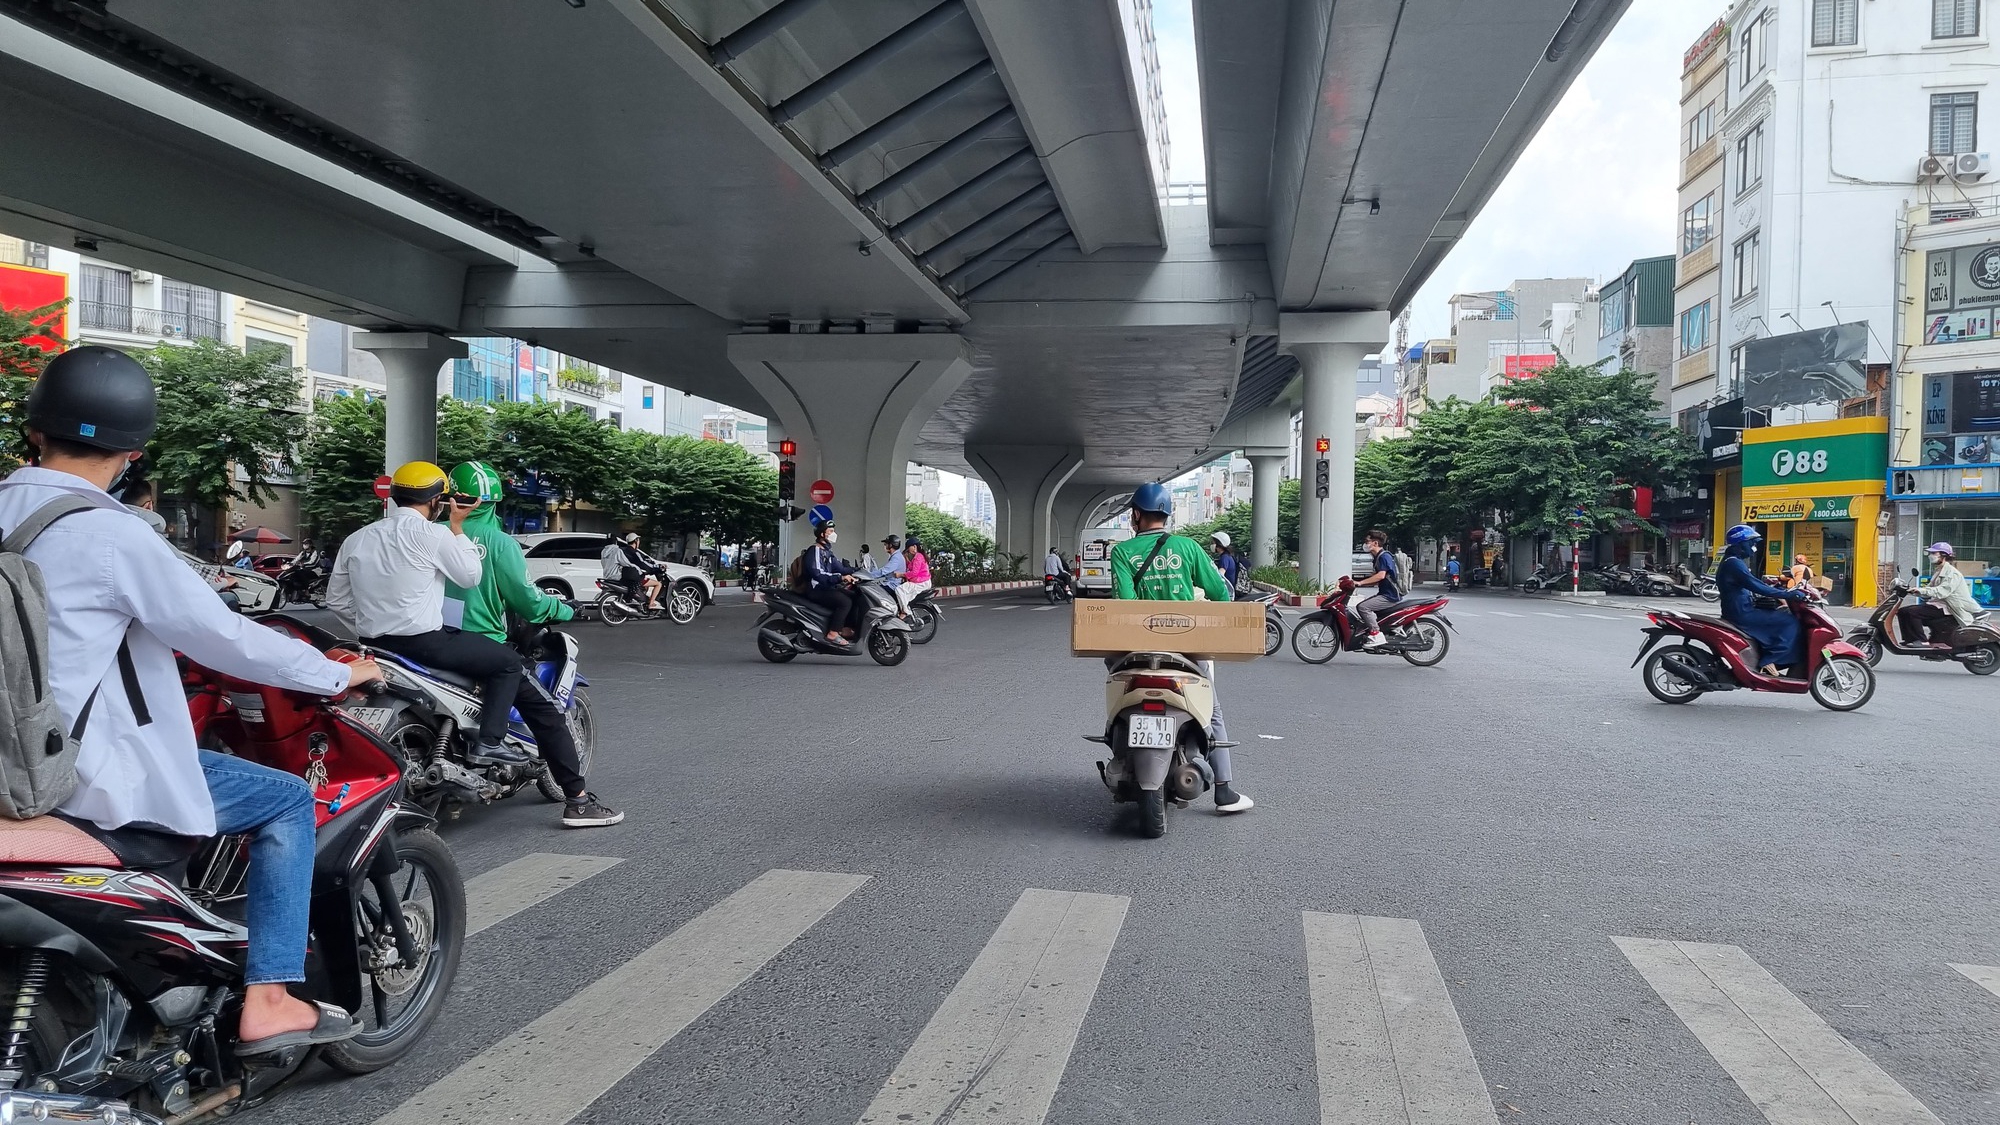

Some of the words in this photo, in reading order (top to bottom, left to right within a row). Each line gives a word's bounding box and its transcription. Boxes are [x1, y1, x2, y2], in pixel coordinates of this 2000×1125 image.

[1959, 294, 2000, 305] phukienngo
[1772, 449, 1828, 476] F88
[1744, 505, 1758, 520] 15
[1772, 503, 1786, 513] CÓ
[1814, 510, 1830, 518] 1800
[1130, 548, 1182, 572] Gab
[1132, 732, 1172, 746] 326.29
